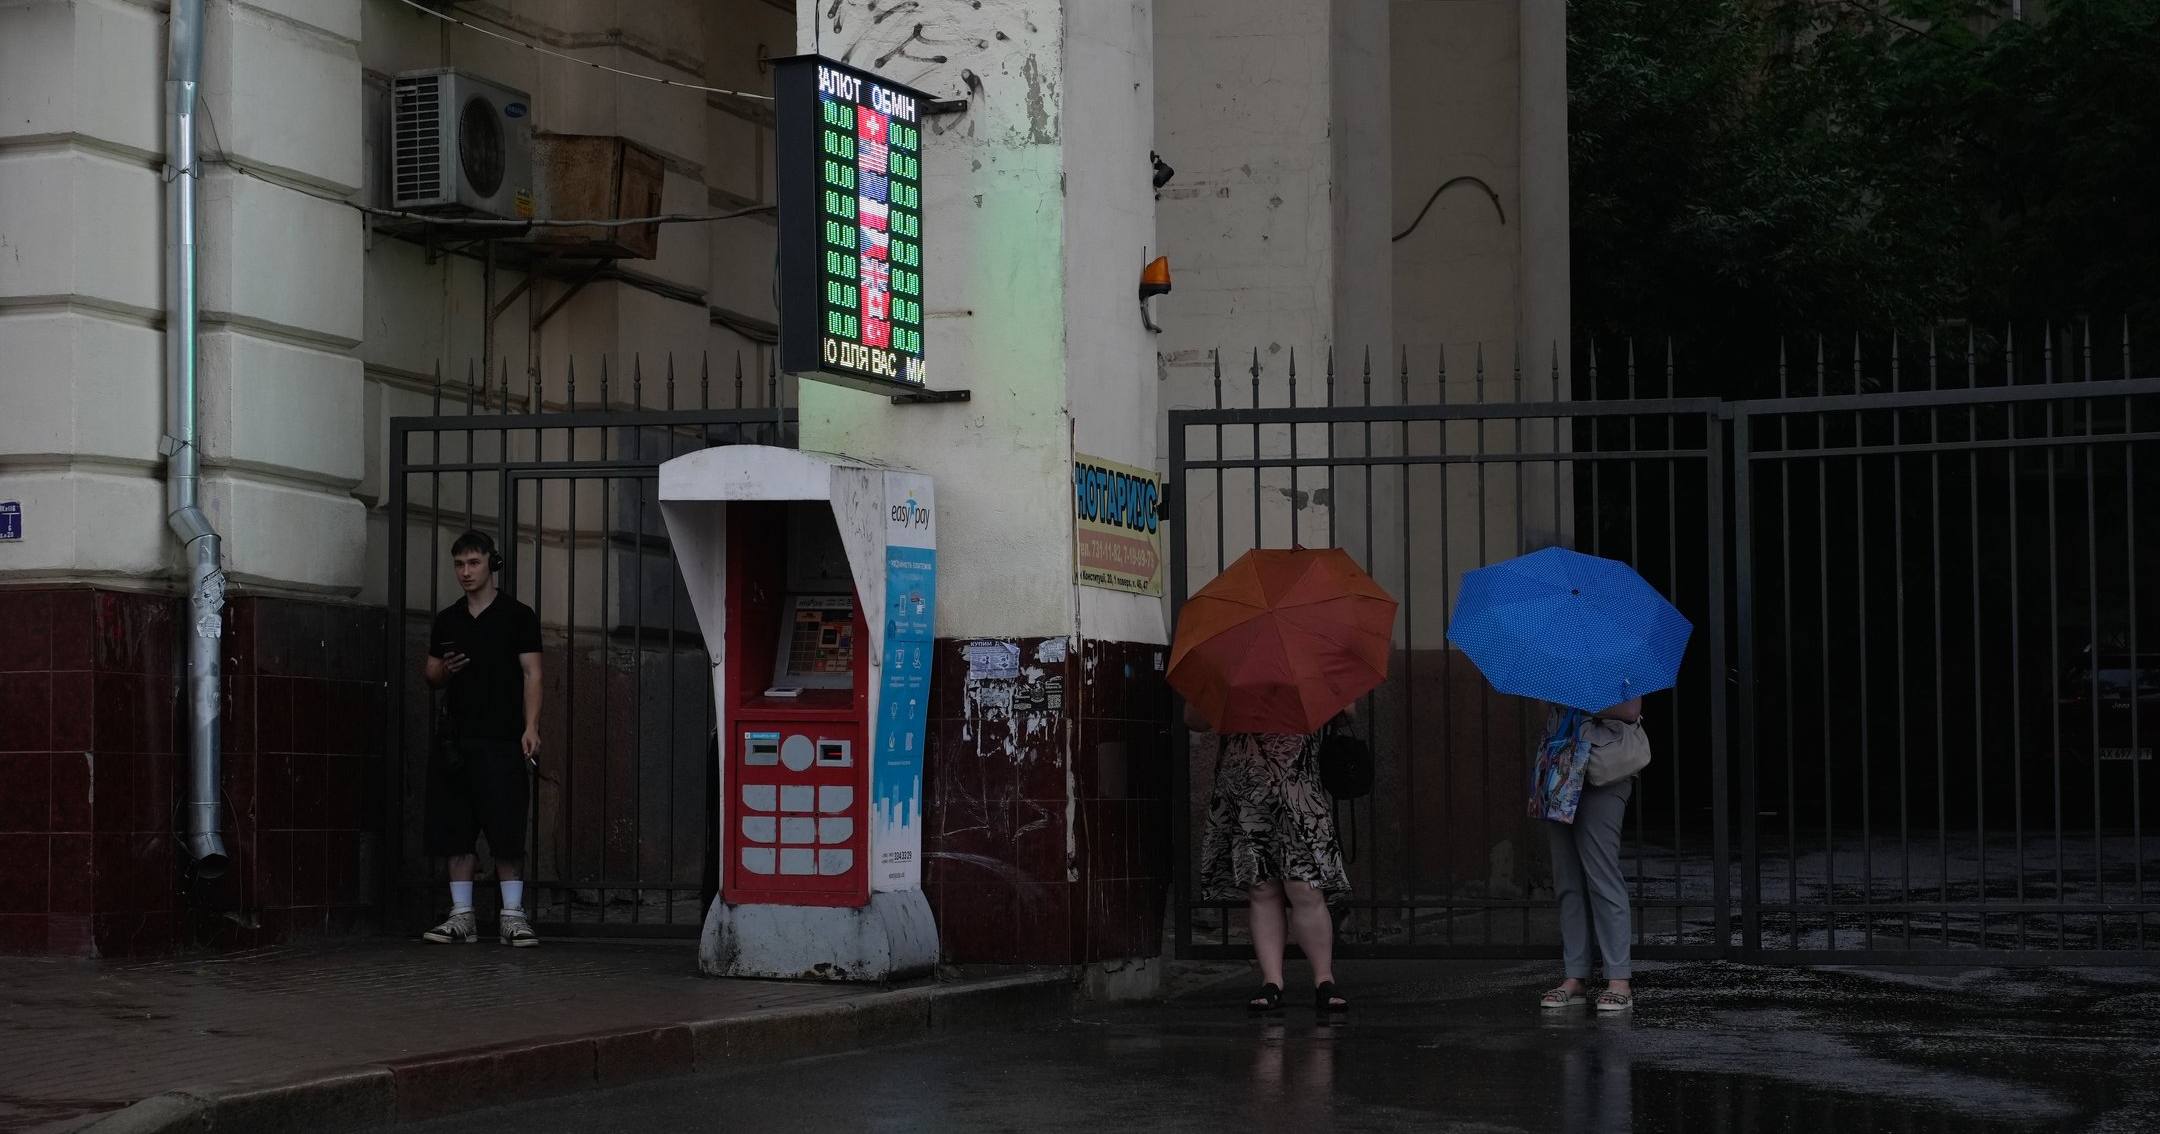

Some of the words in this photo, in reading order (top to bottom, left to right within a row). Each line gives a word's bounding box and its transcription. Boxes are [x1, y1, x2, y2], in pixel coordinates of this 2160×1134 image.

[824, 100, 853, 130] 00.00
[889, 122, 917, 151] 00.00
[871, 85, 915, 123] ОБМІН
[824, 130, 854, 160] 00.00
[890, 152, 917, 180] 00.00
[825, 160, 854, 190] 00.00
[891, 181, 918, 209] 00.00
[826, 190, 855, 219] 00.00
[891, 210, 918, 238] 00.00
[826, 220, 855, 249] 00.00
[892, 239, 919, 267] 00.00
[827, 250, 856, 279] 00.00
[892, 268, 919, 296] 00.00
[828, 281, 856, 309] 00.00
[892, 297, 919, 325] 00.00
[829, 310, 857, 339] 00.00
[893, 327, 920, 354] 00.00
[840, 341, 869, 371] ДЛЯ
[872, 348, 897, 378] ВАС
[906, 356, 926, 385] МИ
[891, 504, 910, 529] easy
[915, 507, 930, 530] pay
[1074, 461, 1157, 535] НОТАРИУС
